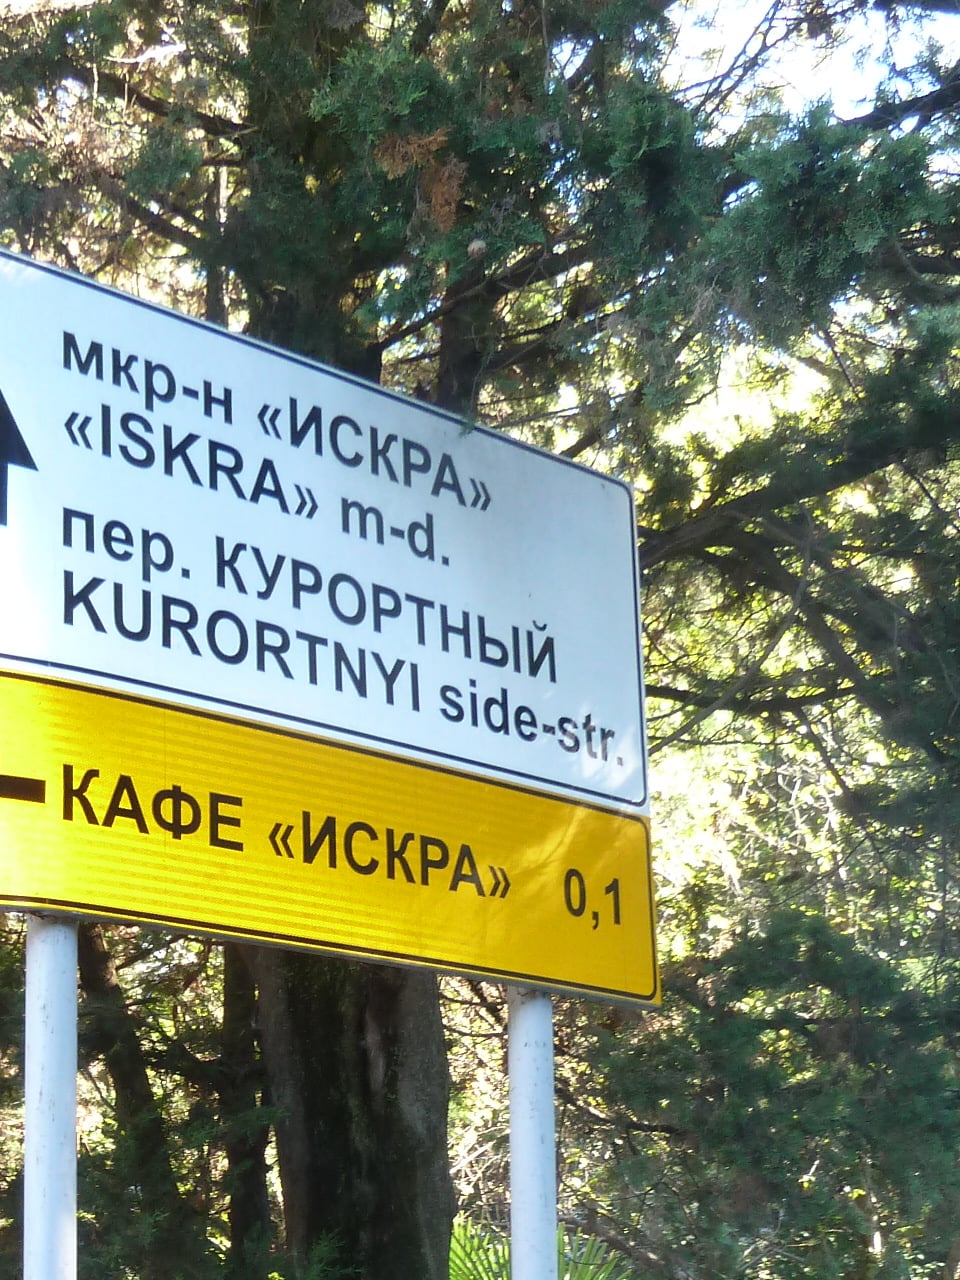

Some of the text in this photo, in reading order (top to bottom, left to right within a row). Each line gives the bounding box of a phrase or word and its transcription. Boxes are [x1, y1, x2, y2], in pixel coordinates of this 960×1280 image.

[62, 331, 492, 512] мкр-н «ИСКРА»
[64, 405, 450, 566] «ISKRA» m-d.
[63, 508, 556, 683] пер. КУРОРТНЫЙ
[64, 570, 624, 765] KURORTNYI side-str.
[63, 764, 622, 929] КАФЕ «ИСКРА» 0,1
